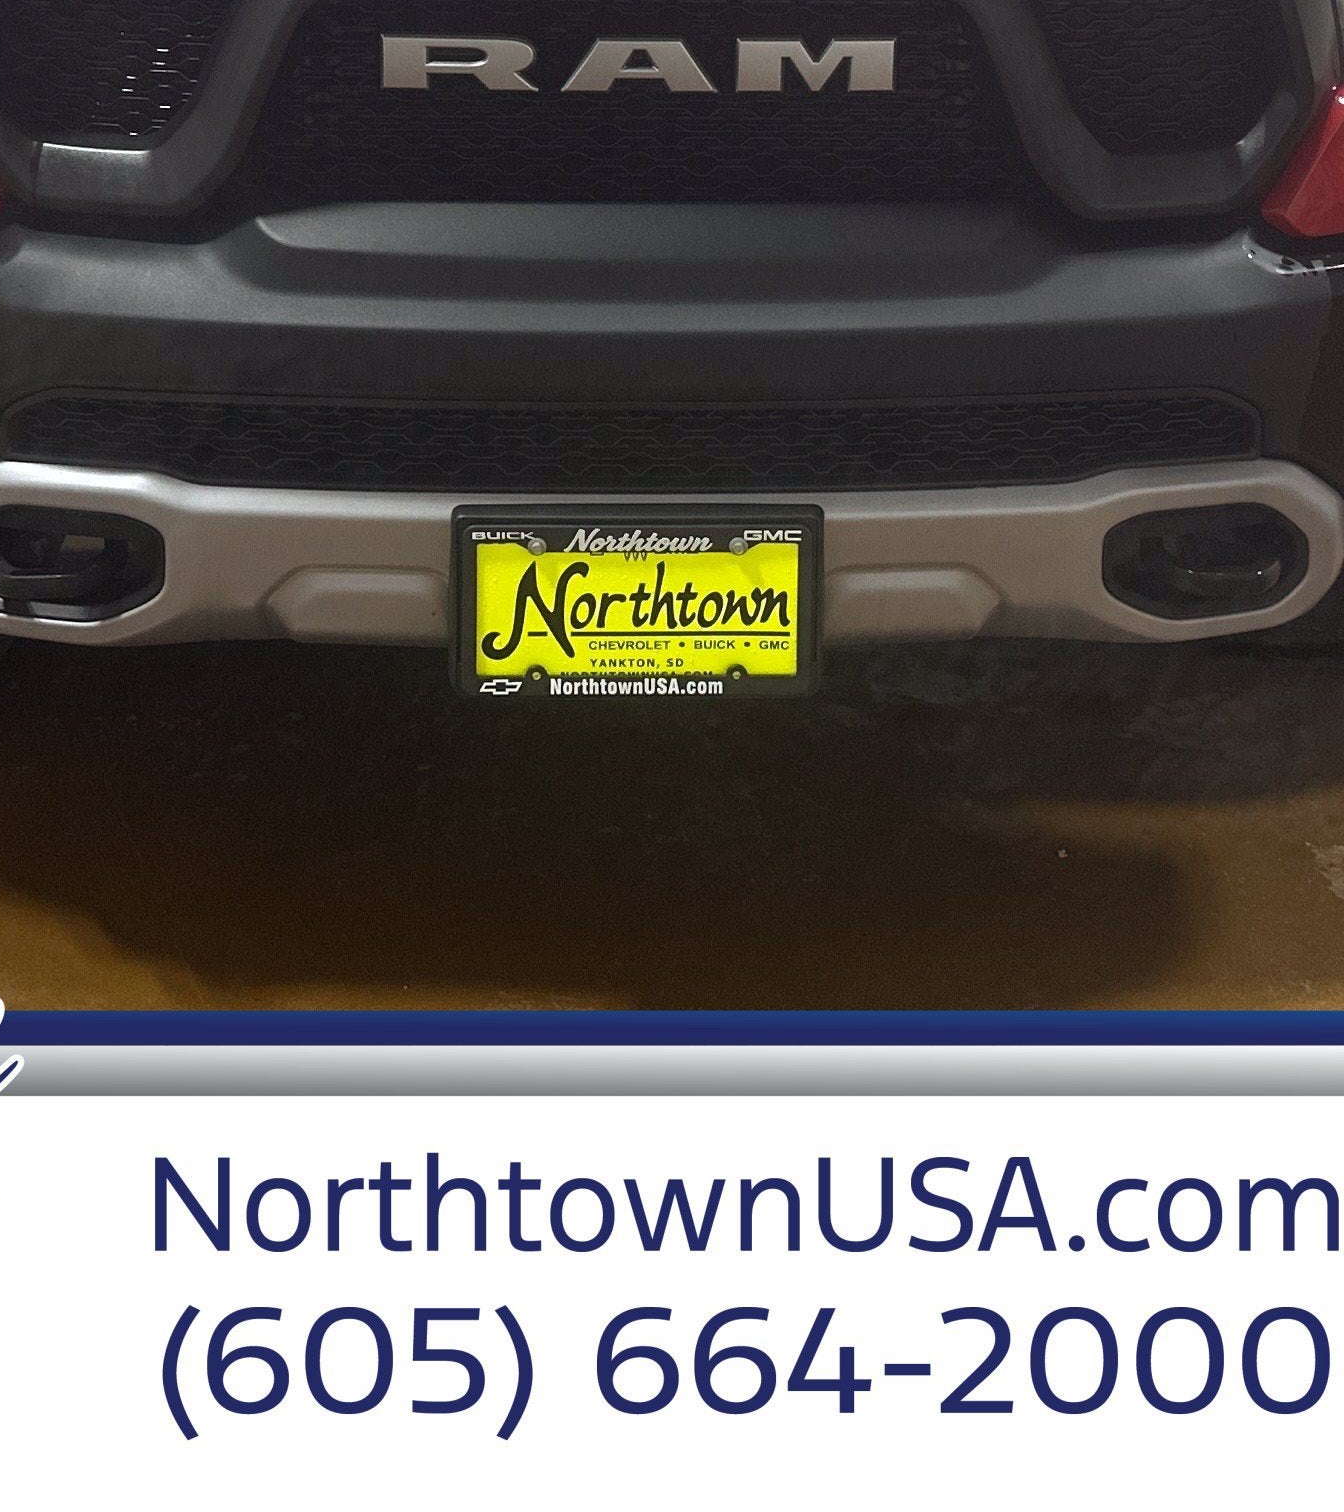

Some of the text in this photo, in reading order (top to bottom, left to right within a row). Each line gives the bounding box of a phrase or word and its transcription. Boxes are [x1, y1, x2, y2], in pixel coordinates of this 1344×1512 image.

[381, 33, 896, 92] RAM
[471, 531, 534, 541] BUICK
[563, 528, 714, 553] Northtown
[743, 529, 802, 542] GMC
[481, 560, 791, 661] Northtown
[588, 639, 790, 651] CHEVROLET BUICK GMC
[589, 658, 684, 670] YANKTON, SD
[549, 677, 724, 696] NorthtownUSA.com
